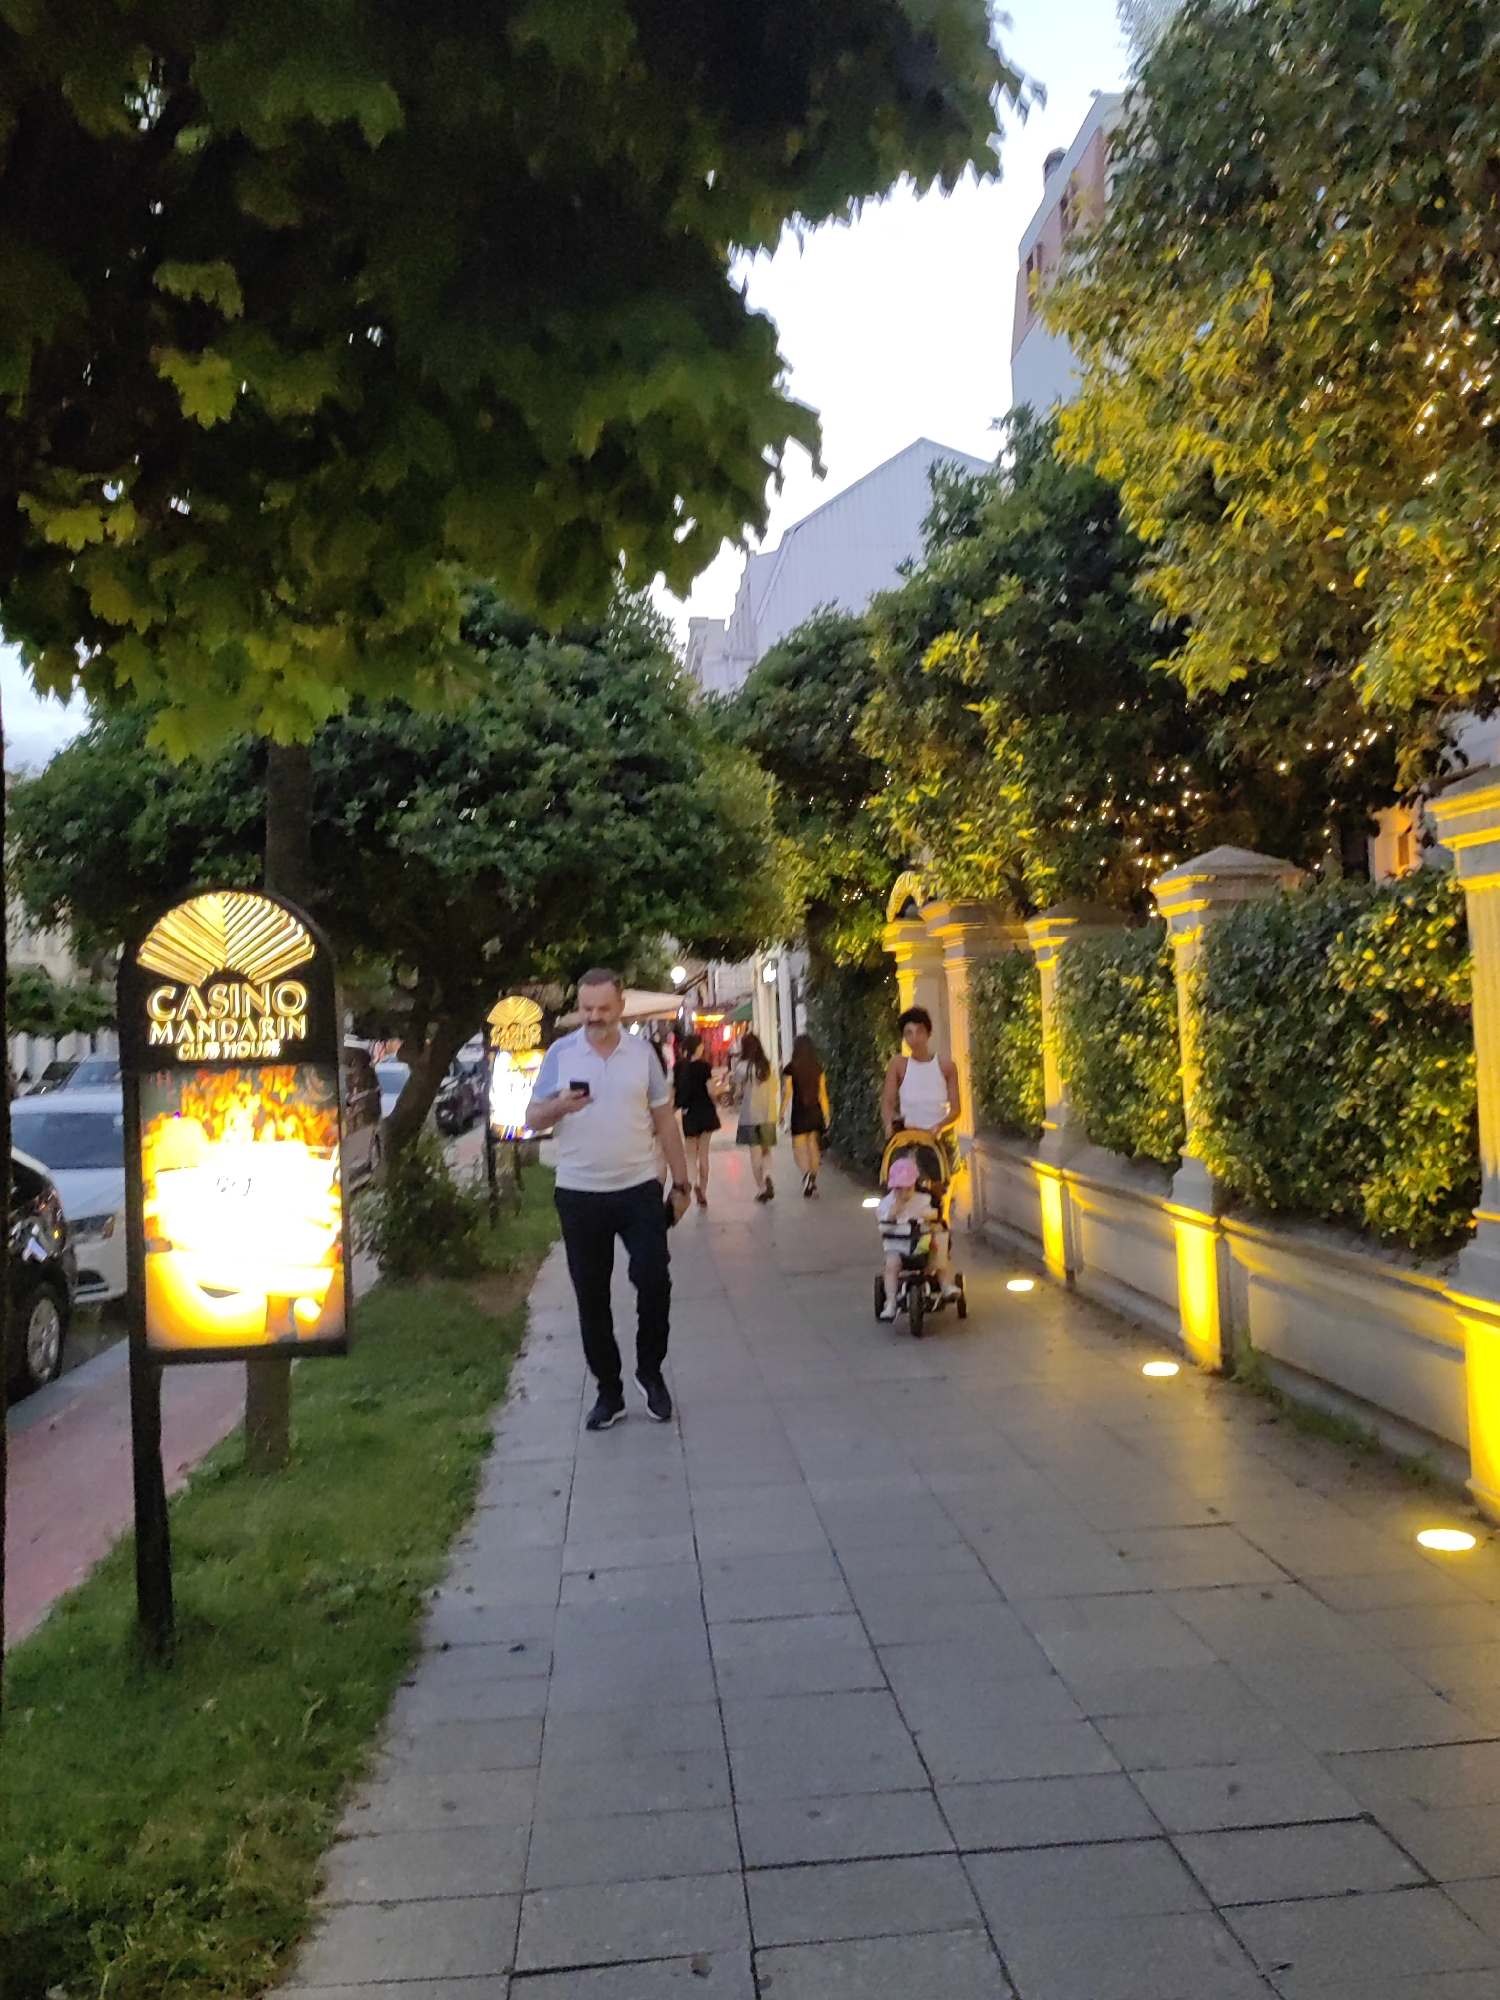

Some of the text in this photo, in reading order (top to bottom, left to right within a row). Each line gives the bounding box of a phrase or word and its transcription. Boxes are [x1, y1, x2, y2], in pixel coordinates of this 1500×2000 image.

[146, 980, 307, 1022] CASINO
[149, 1014, 307, 1045] MANDARIN
[177, 1038, 281, 1061] CLUB HOUSE
